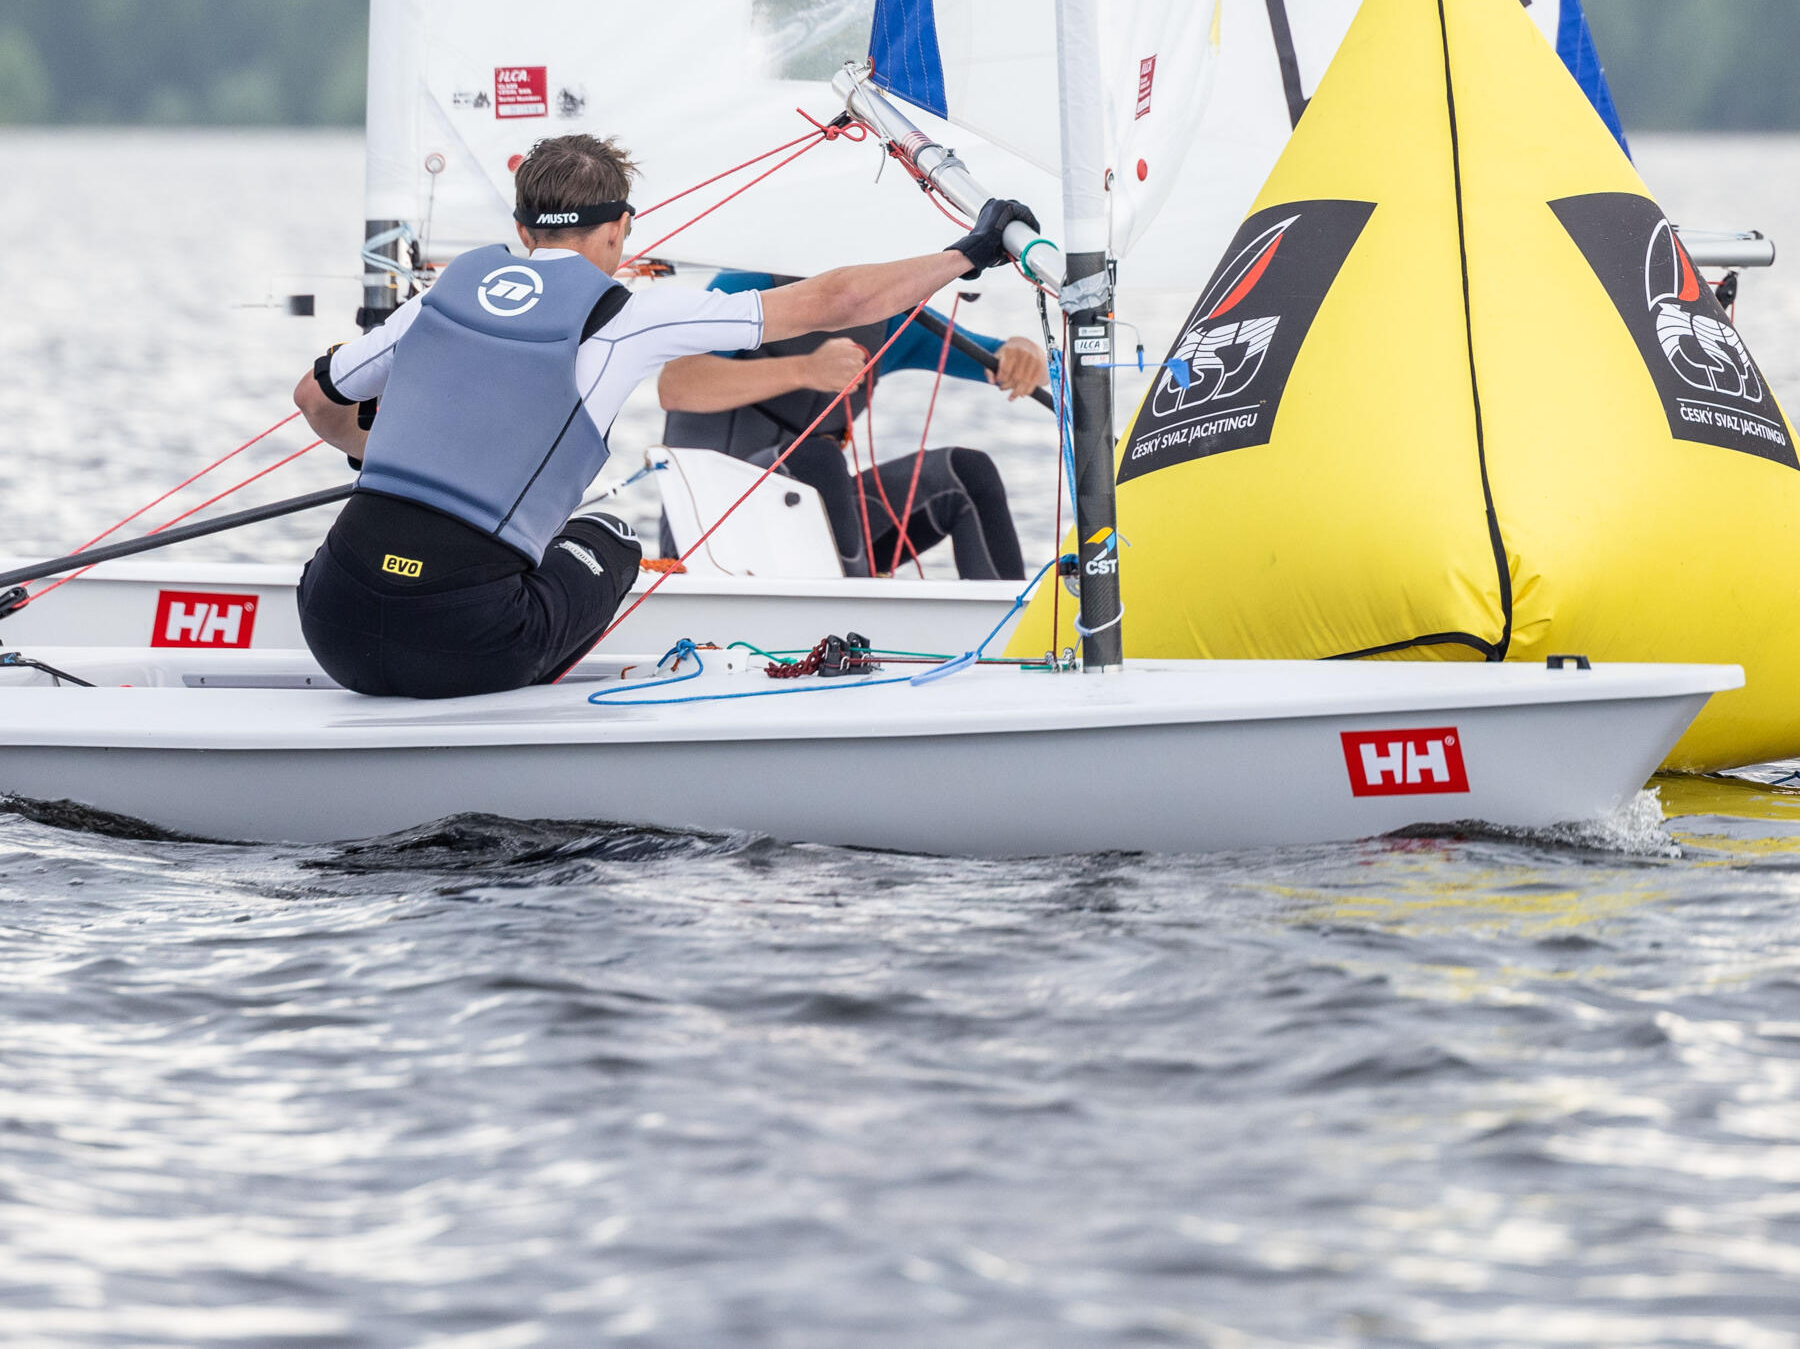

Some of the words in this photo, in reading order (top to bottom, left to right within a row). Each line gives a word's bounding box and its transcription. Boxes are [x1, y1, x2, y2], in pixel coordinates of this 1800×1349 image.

[536, 212, 579, 224] MUSTO
[1080, 340, 1100, 349] ILCA
[1680, 403, 1713, 425] ČESKÝ
[1716, 414, 1740, 431] SVAZ
[1740, 419, 1786, 447] JACHTINGU
[1131, 433, 1162, 460] ČESKÝ
[1161, 429, 1188, 449] SVAZ
[1187, 413, 1258, 446] JACHTINGU
[386, 556, 419, 575] evo
[1086, 559, 1117, 575] CST
